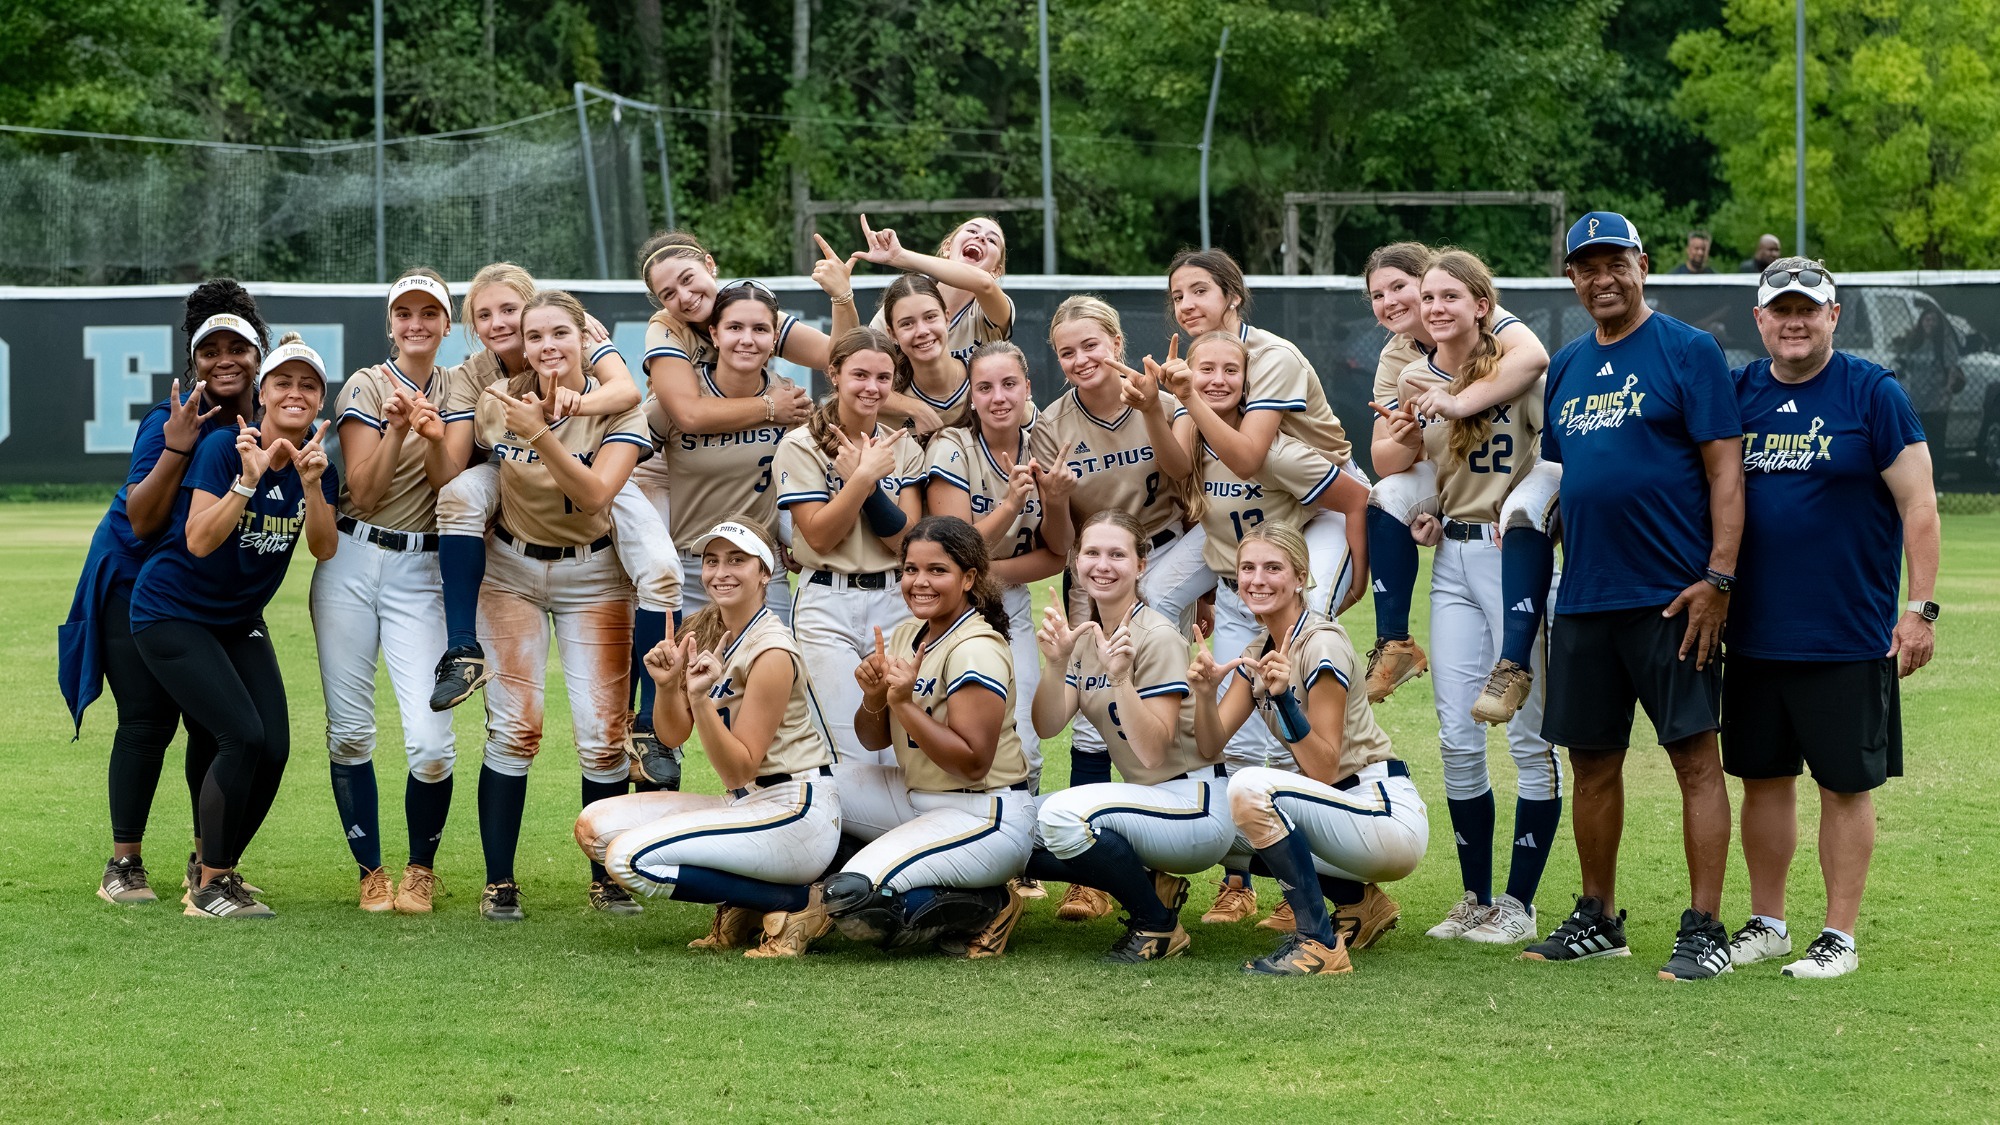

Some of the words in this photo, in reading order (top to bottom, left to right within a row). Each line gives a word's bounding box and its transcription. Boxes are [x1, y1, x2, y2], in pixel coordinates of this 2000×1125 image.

[410, 278, 428, 286] PIUS
[207, 316, 240, 329] LIONS
[282, 346, 315, 360] LIONS
[1584, 391, 1625, 420] PIUS
[1627, 391, 1646, 417] X
[1566, 407, 1628, 436] Softball
[1468, 433, 1514, 475] 22
[1763, 433, 1812, 459] PIUS
[1815, 435, 1834, 461] X
[1743, 450, 1816, 474] Softball
